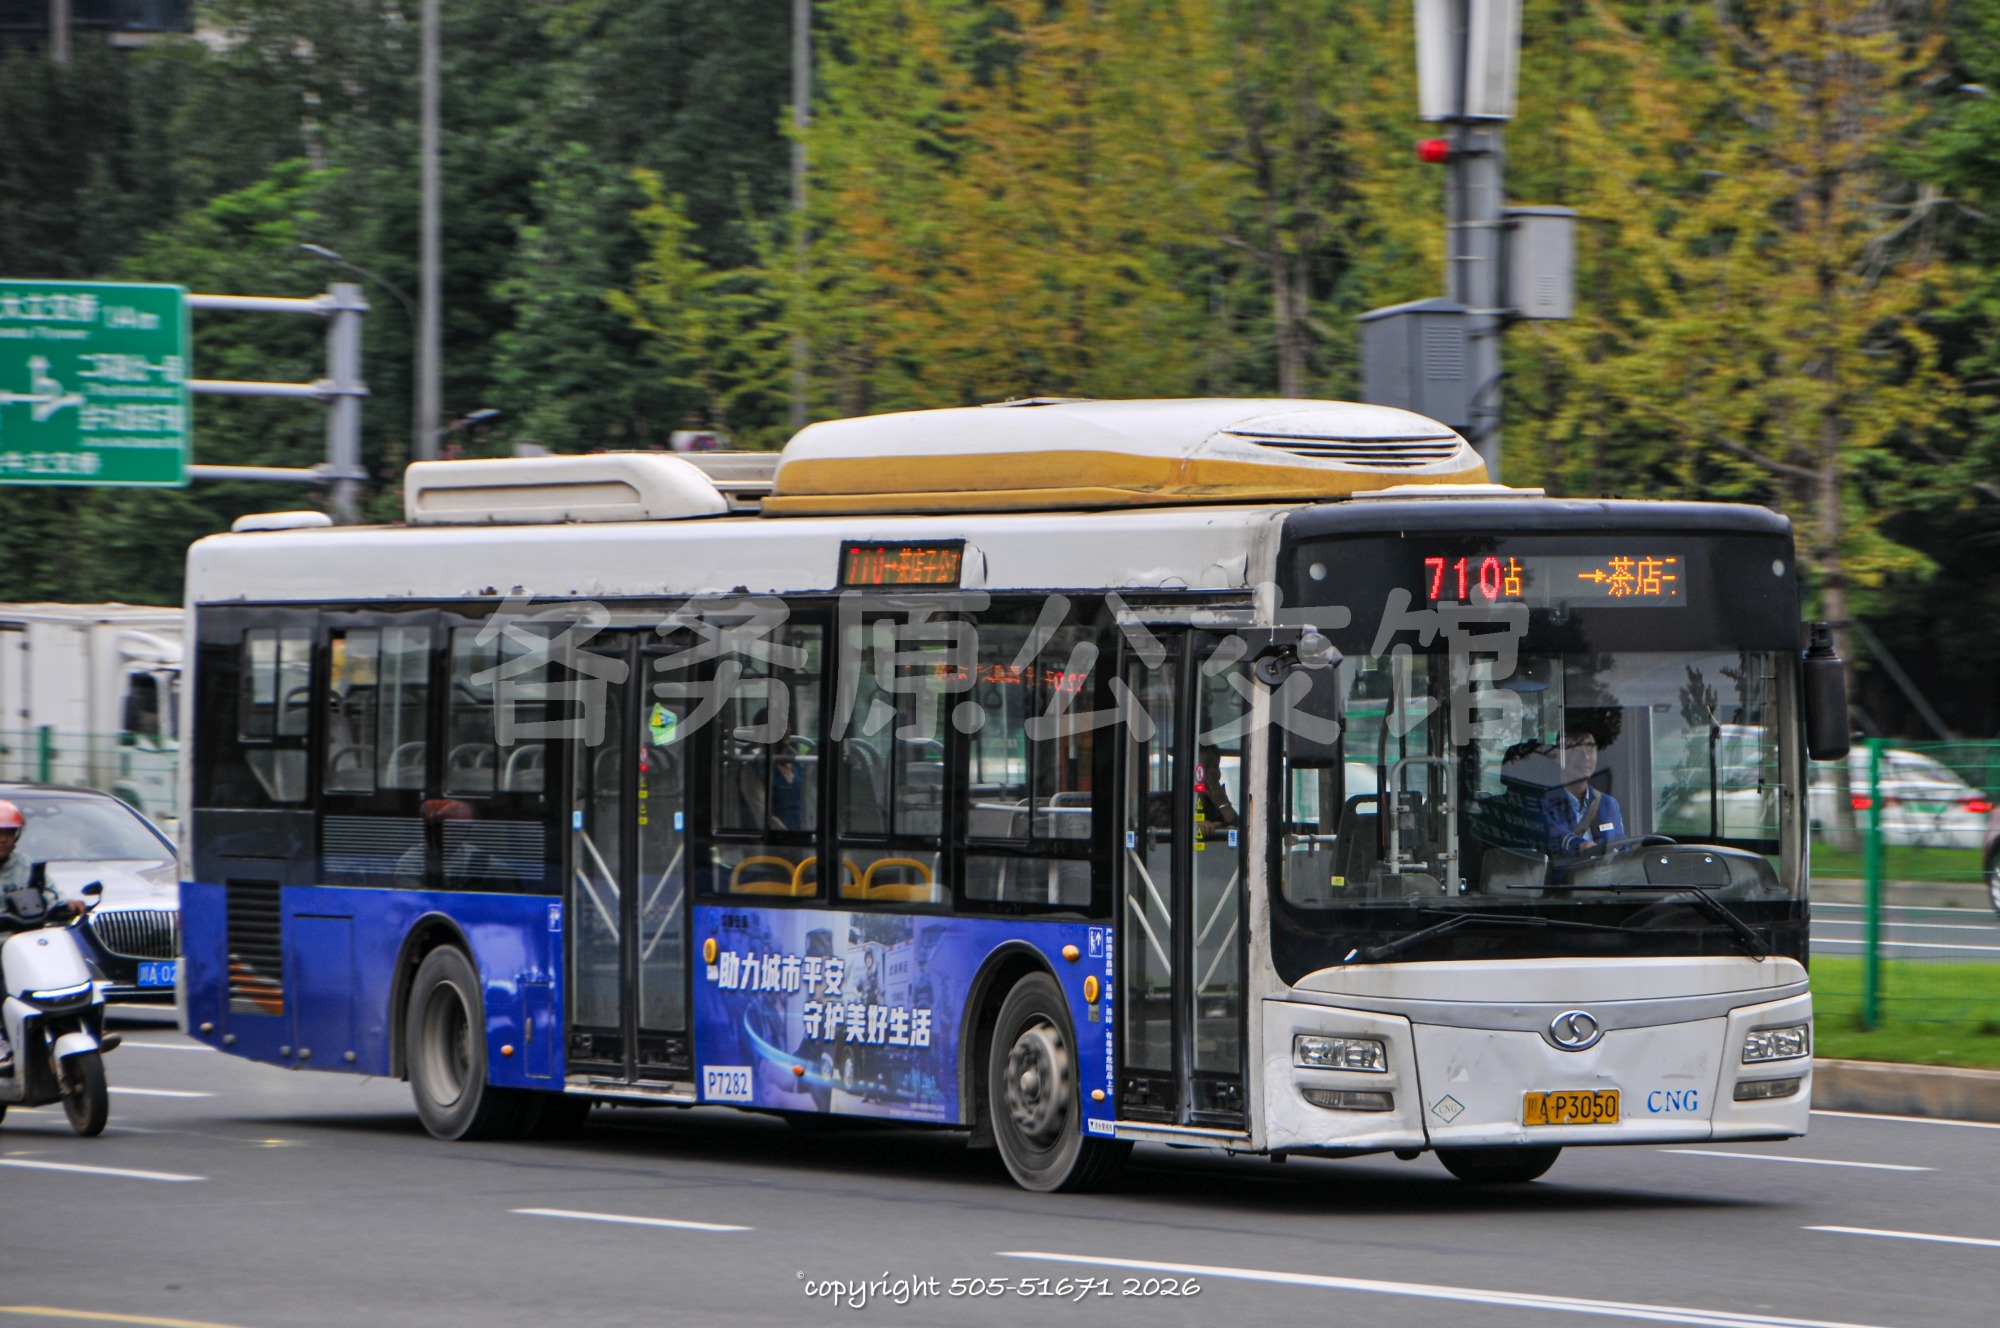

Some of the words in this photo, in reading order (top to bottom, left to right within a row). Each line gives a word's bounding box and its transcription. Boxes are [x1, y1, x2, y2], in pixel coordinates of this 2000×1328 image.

[1425, 556, 1501, 599] 710
[718, 951, 845, 997] 助力城市平安
[803, 1001, 931, 1047] 守护美好生活
[707, 1071, 748, 1095] P7282
[1438, 1103, 1458, 1113] CNG
[1647, 1089, 1698, 1113] CNG
